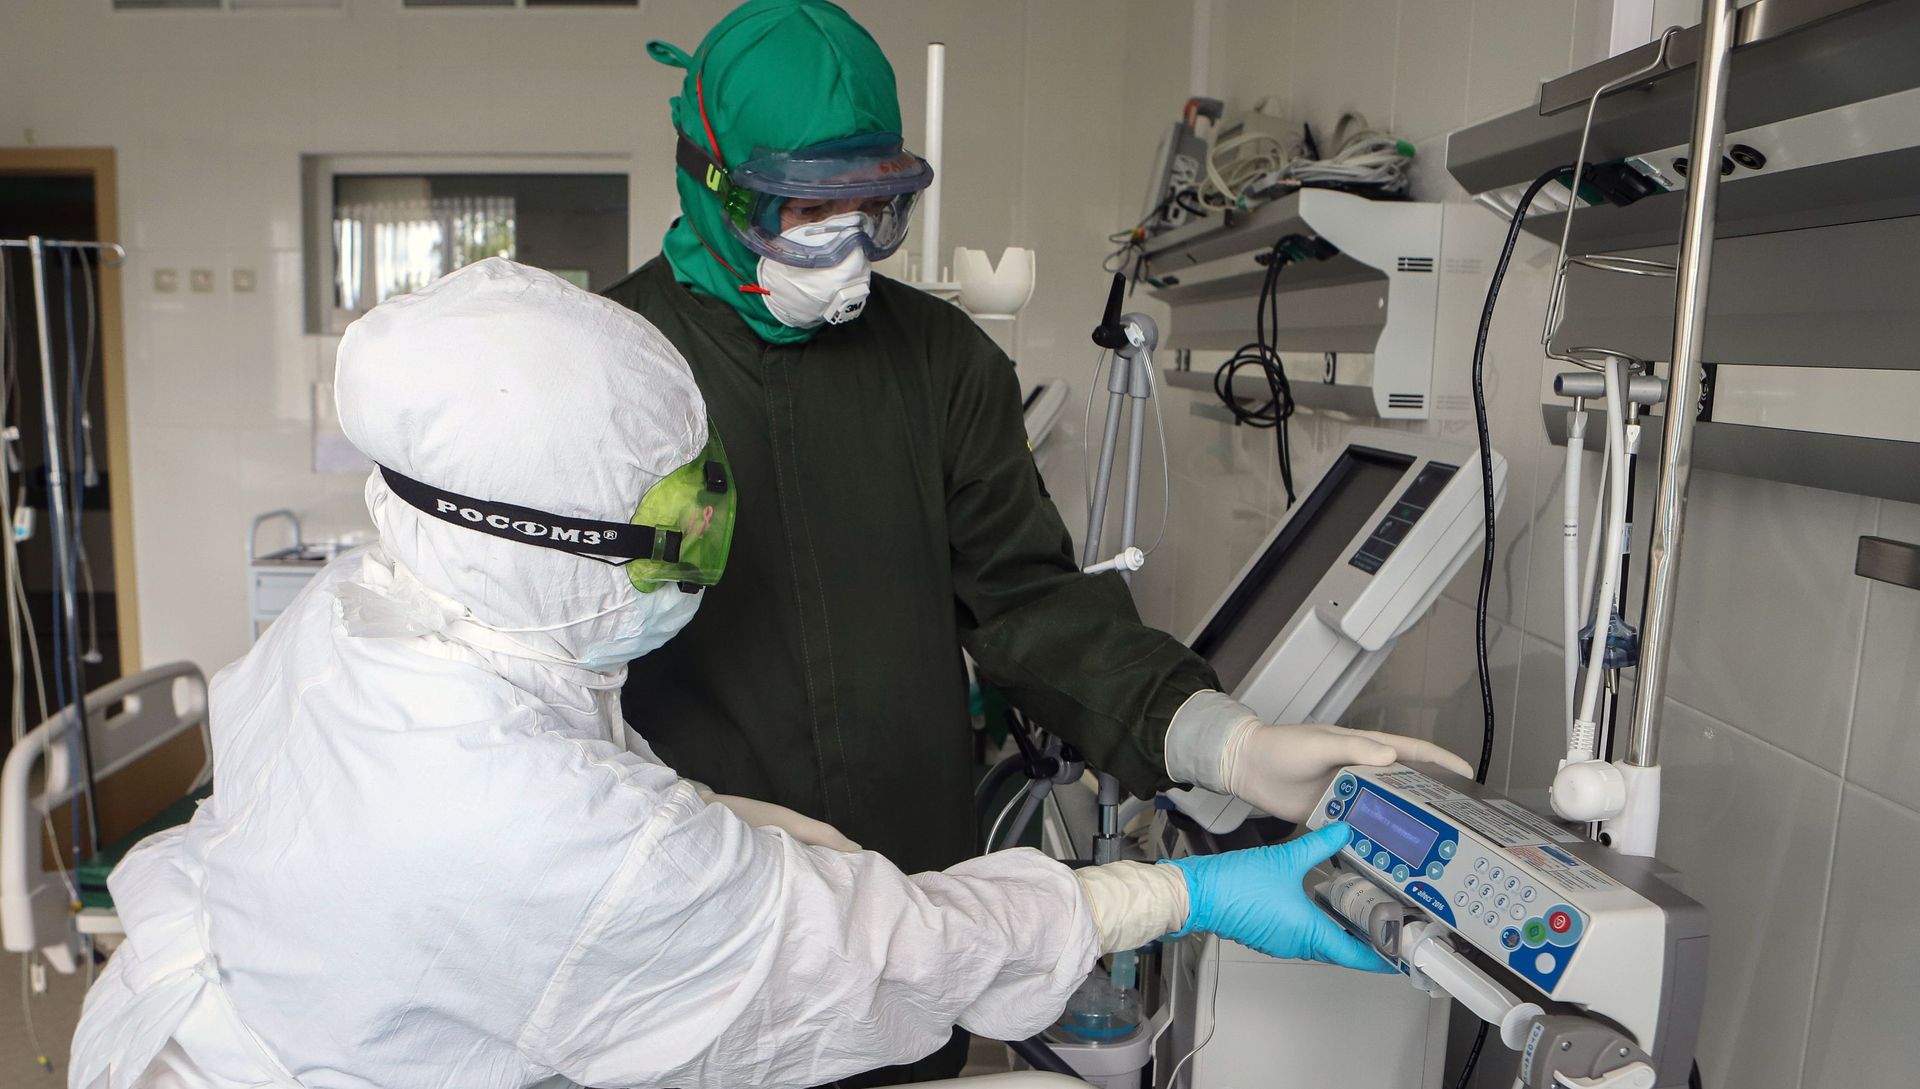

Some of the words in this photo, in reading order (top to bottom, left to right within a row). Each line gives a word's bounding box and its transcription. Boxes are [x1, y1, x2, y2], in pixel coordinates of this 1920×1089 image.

[845, 301, 863, 313] 3M
[1492, 870, 1500, 879] 8
[1508, 880, 1516, 888] 9
[1524, 890, 1532, 898] 0
[1482, 887, 1490, 896] 5
[1497, 897, 1505, 906] 6
[1472, 905, 1480, 913] 2
[1487, 915, 1495, 923] 3
